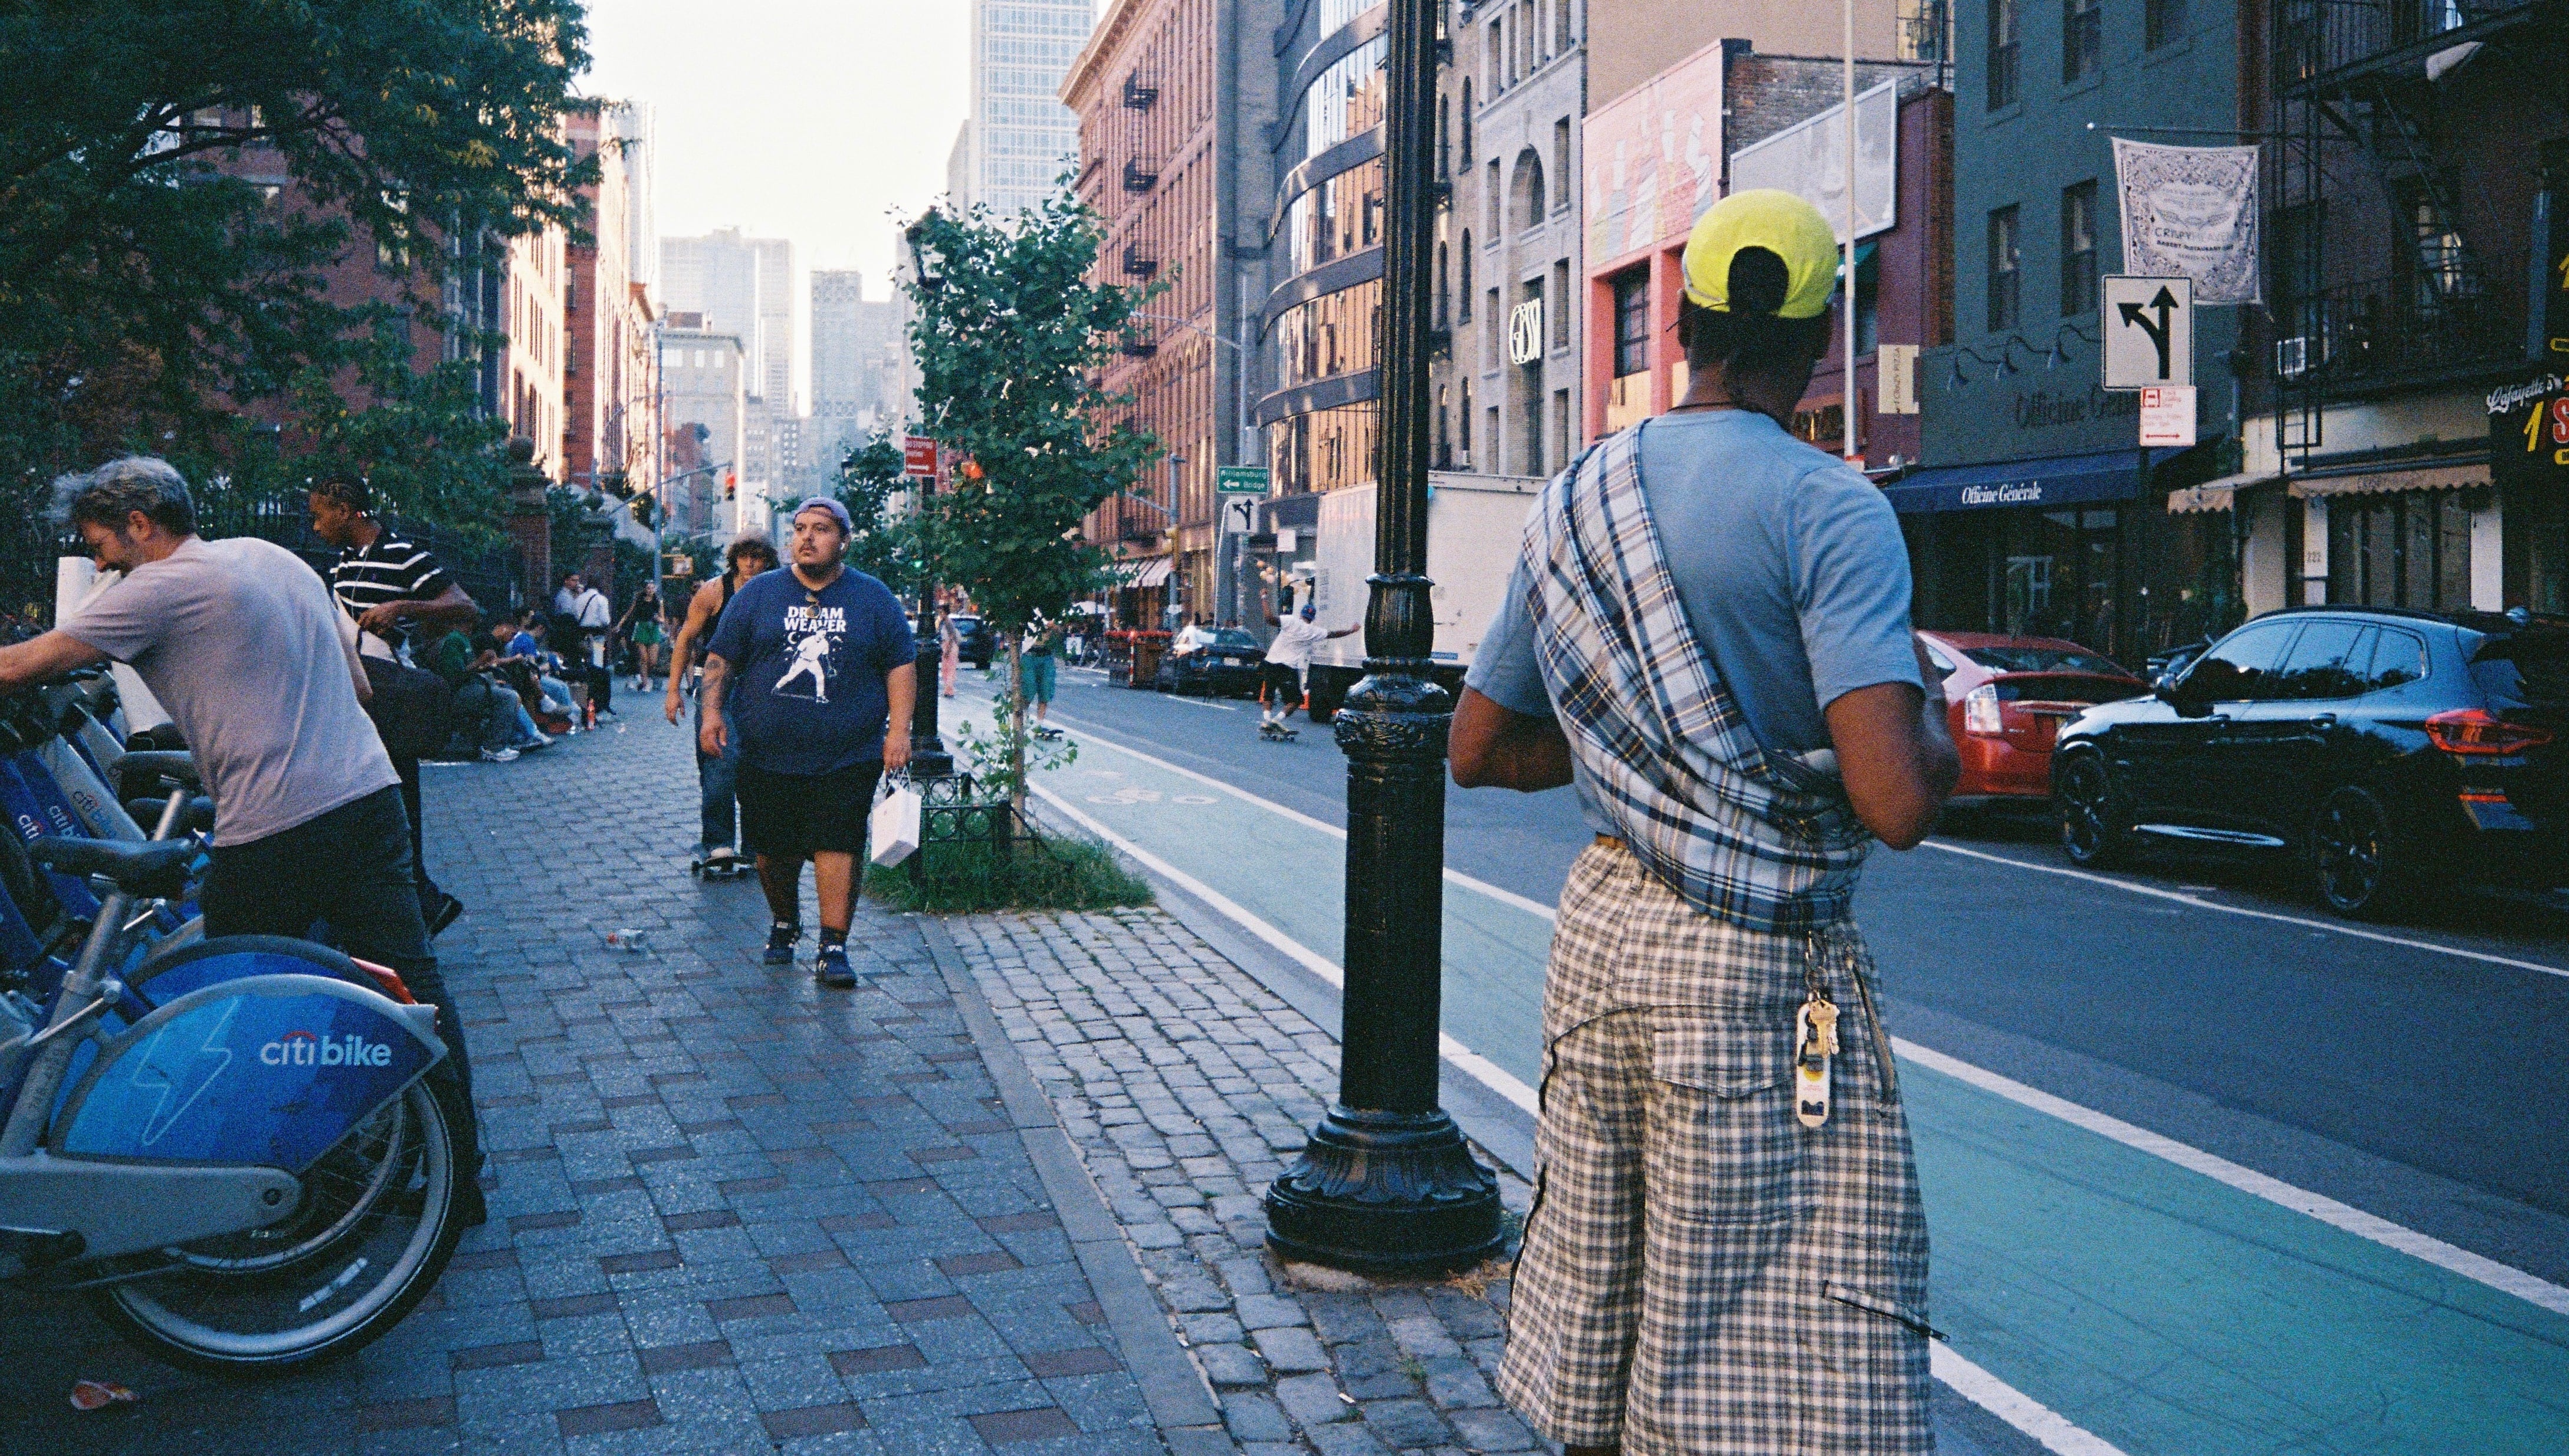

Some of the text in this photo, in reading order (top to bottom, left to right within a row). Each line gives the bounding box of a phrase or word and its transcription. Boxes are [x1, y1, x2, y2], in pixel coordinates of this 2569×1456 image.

[1962, 485, 1998, 504] Officine
[784, 617, 847, 632] WEAVER
[18, 814, 43, 840] citi
[260, 1032, 392, 1067] citi bike
